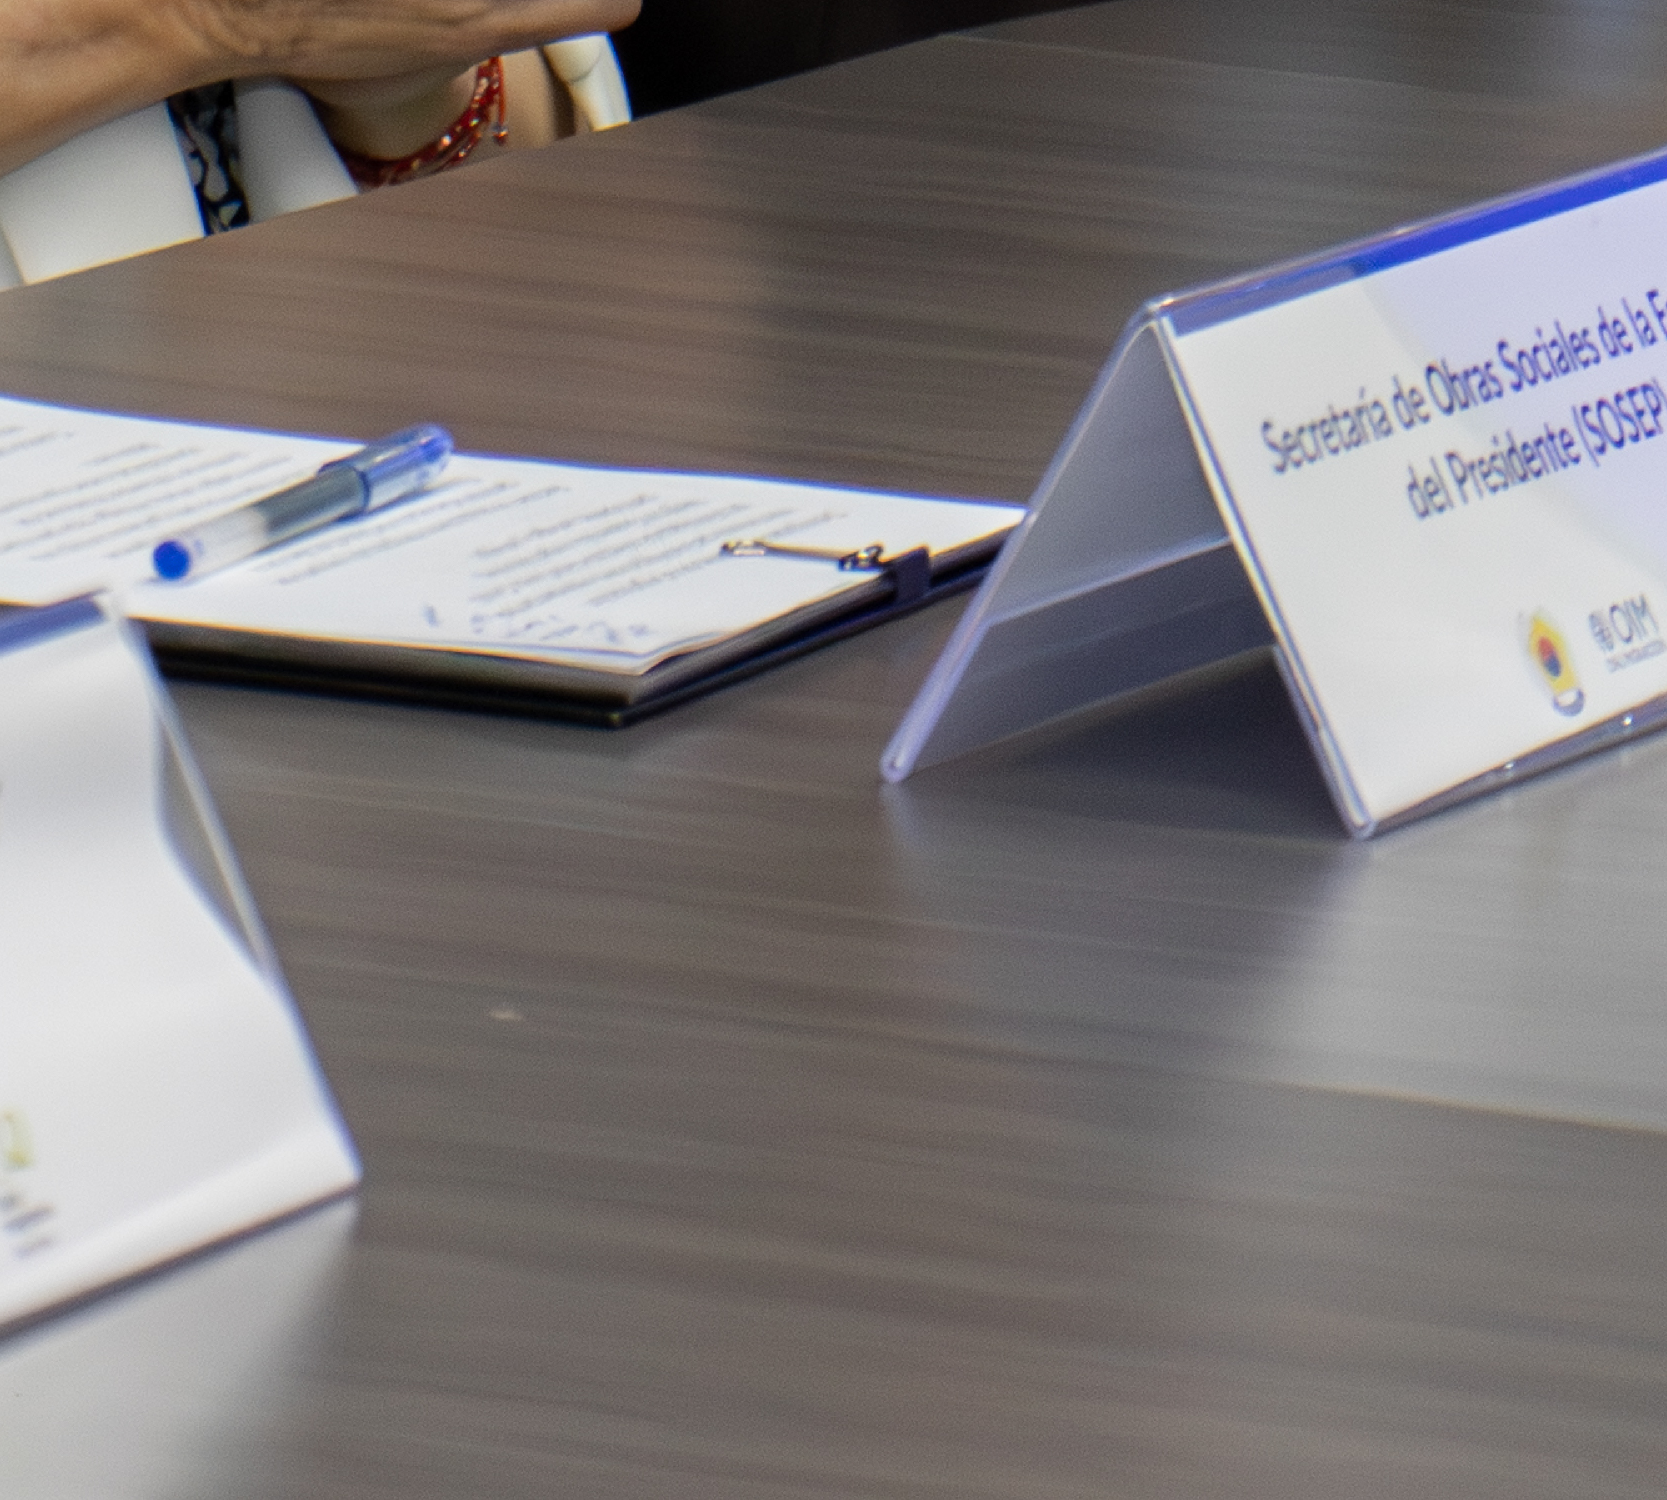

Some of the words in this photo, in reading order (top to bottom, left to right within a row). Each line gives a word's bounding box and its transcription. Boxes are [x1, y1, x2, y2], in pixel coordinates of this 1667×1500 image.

[1260, 386, 1395, 474] Secretaría
[1390, 374, 1431, 431] de
[1424, 357, 1505, 417] Obras
[1496, 320, 1602, 392] Sociales
[1595, 304, 1634, 359] de
[1621, 297, 1658, 349] la
[1405, 456, 1455, 520] del
[1444, 421, 1582, 505] Presidente
